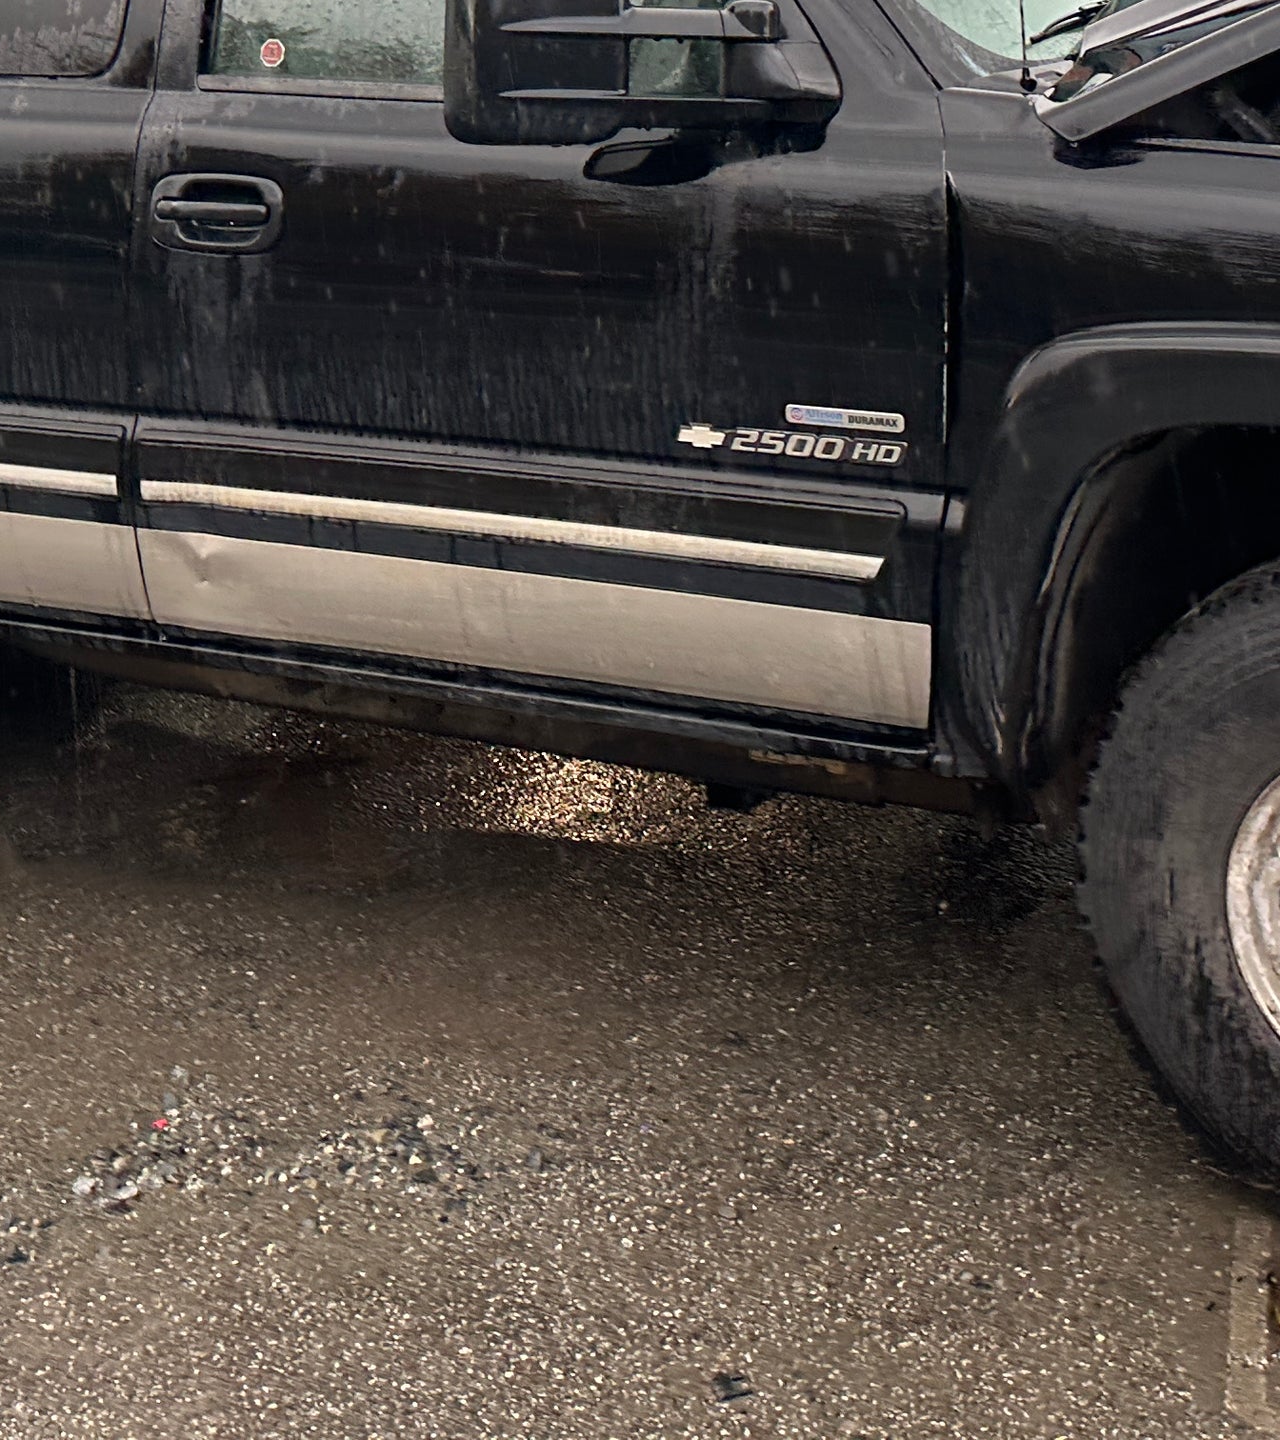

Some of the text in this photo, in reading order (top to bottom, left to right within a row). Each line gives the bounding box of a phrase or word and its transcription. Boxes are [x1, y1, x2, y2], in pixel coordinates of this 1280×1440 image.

[847, 414, 899, 428] DURAMAX
[730, 428, 902, 464] 2500 HD
